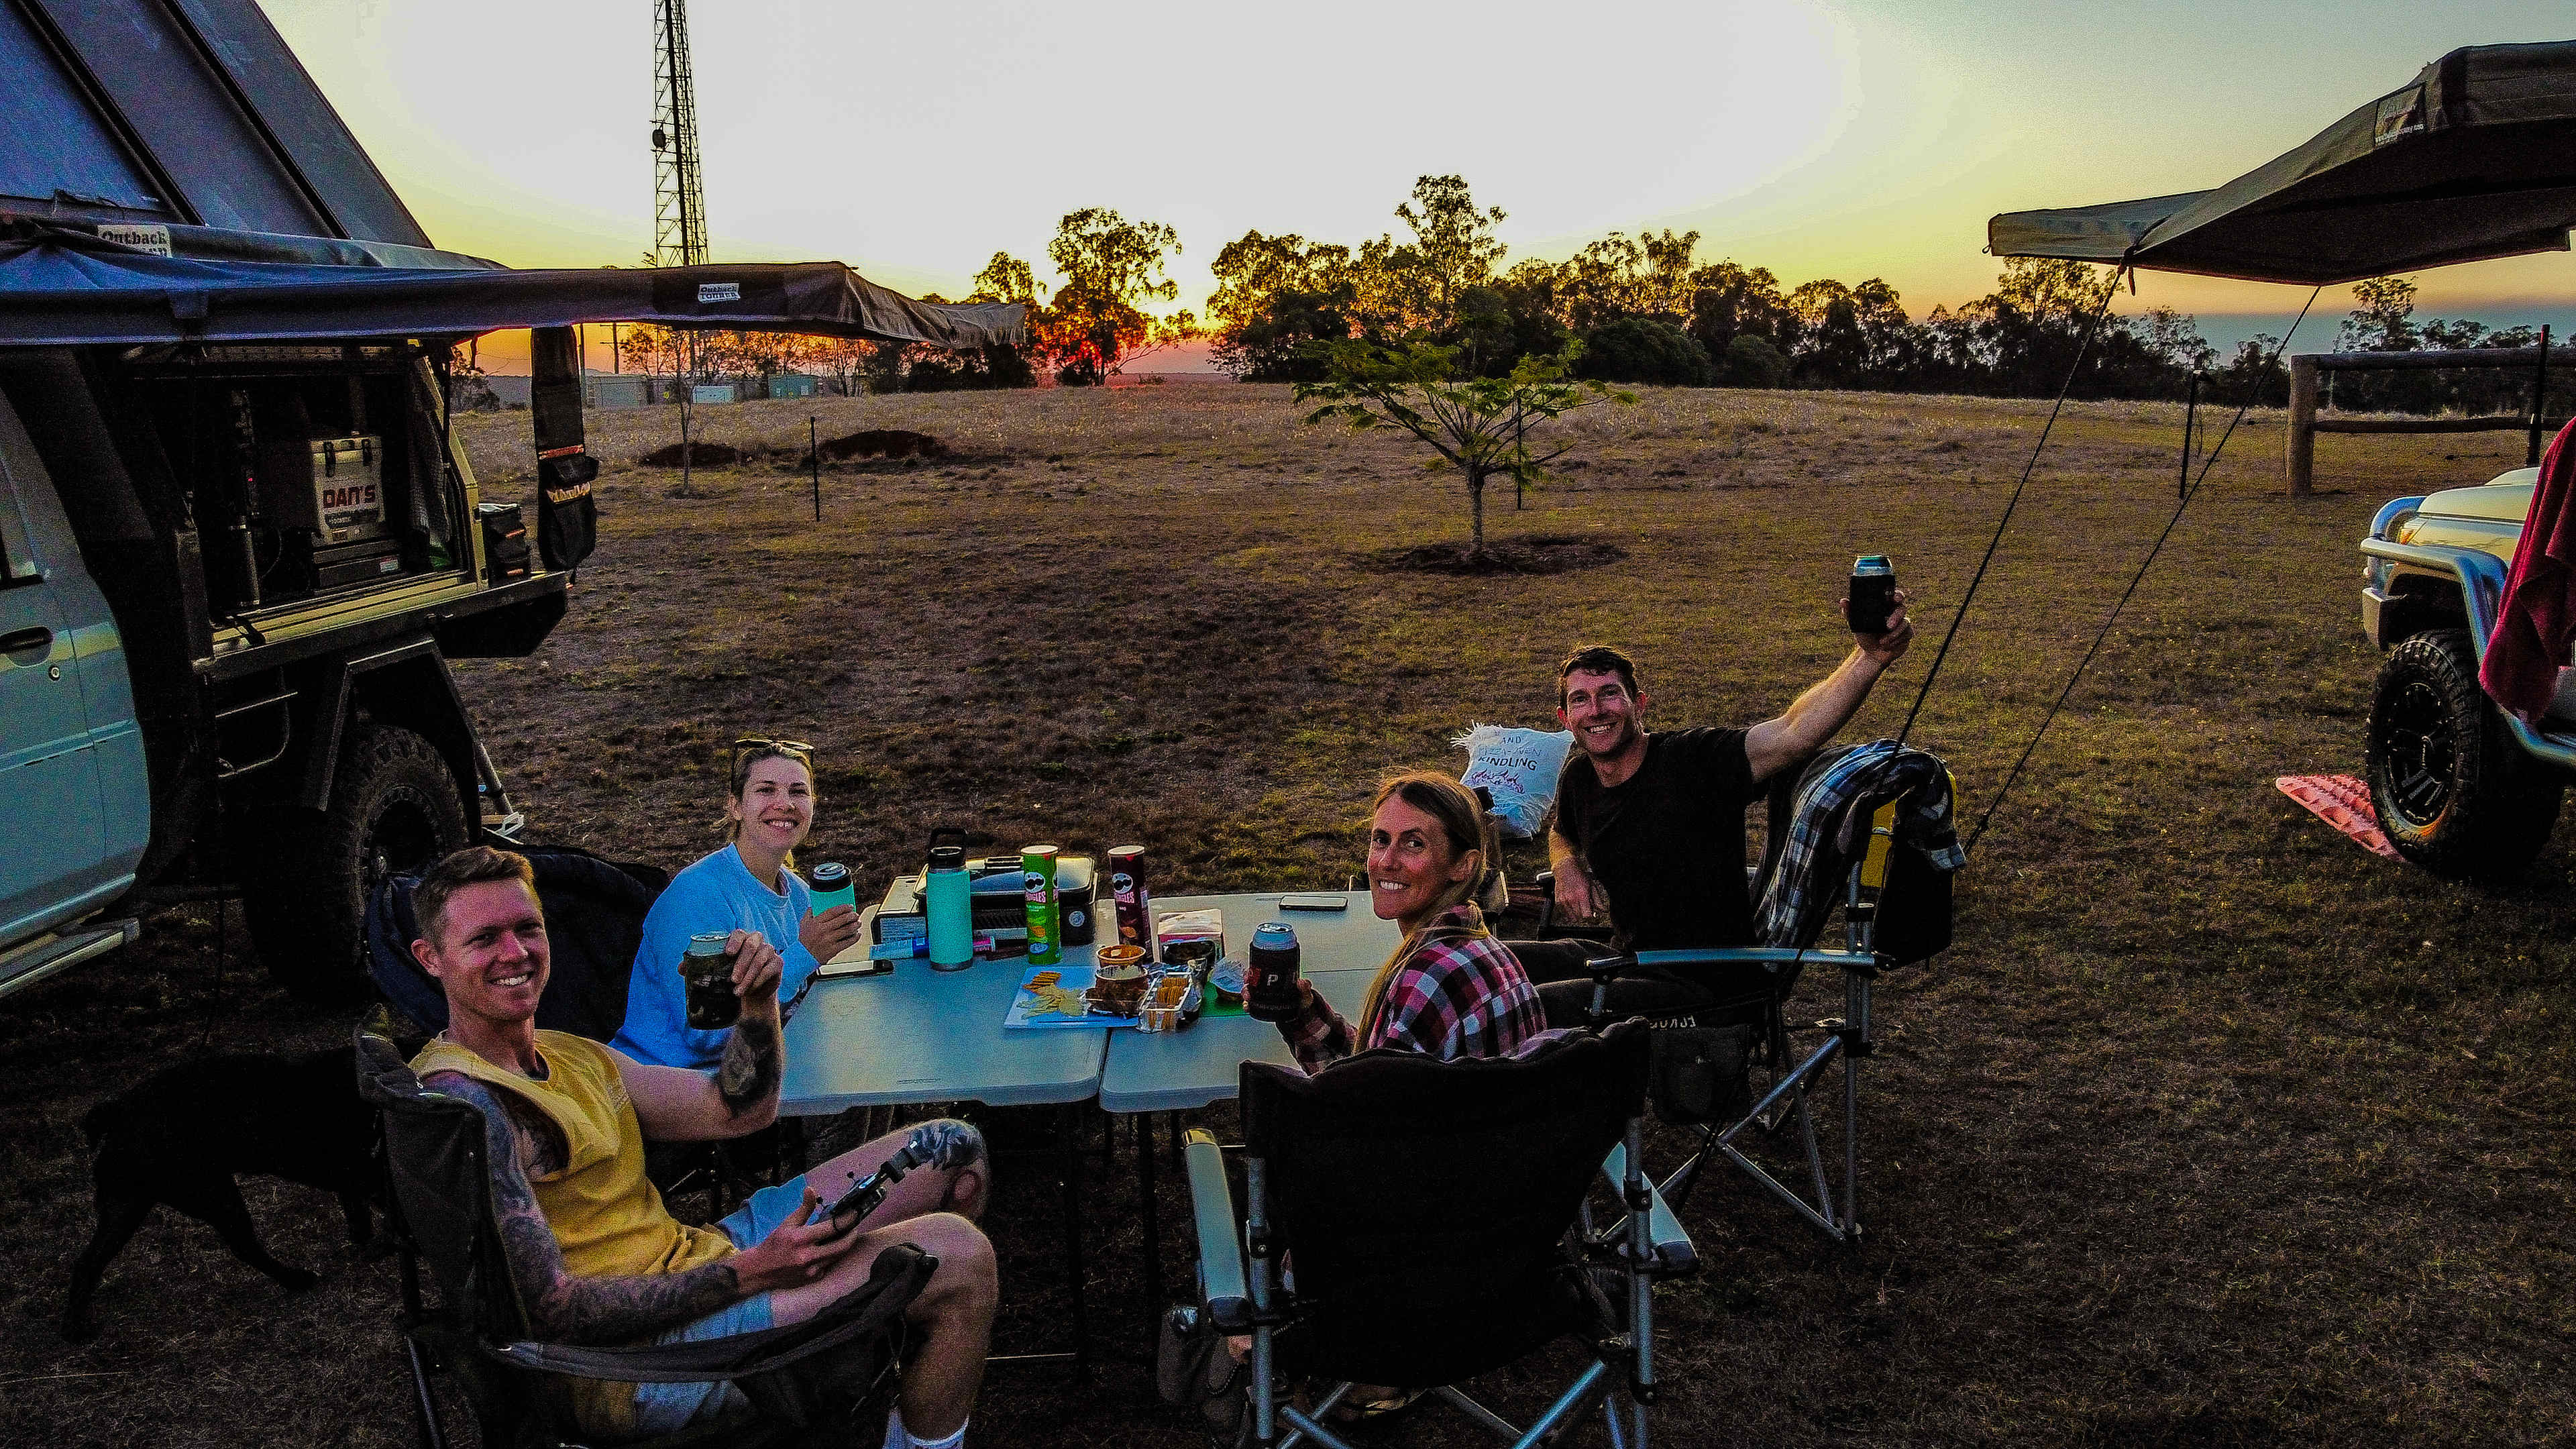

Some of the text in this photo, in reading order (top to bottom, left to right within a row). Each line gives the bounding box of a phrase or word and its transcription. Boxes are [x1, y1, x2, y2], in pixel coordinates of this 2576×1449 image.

[101, 231, 168, 245] Outback
[1502, 736, 1521, 745] AND
[1478, 755, 1538, 771] KINDLING
